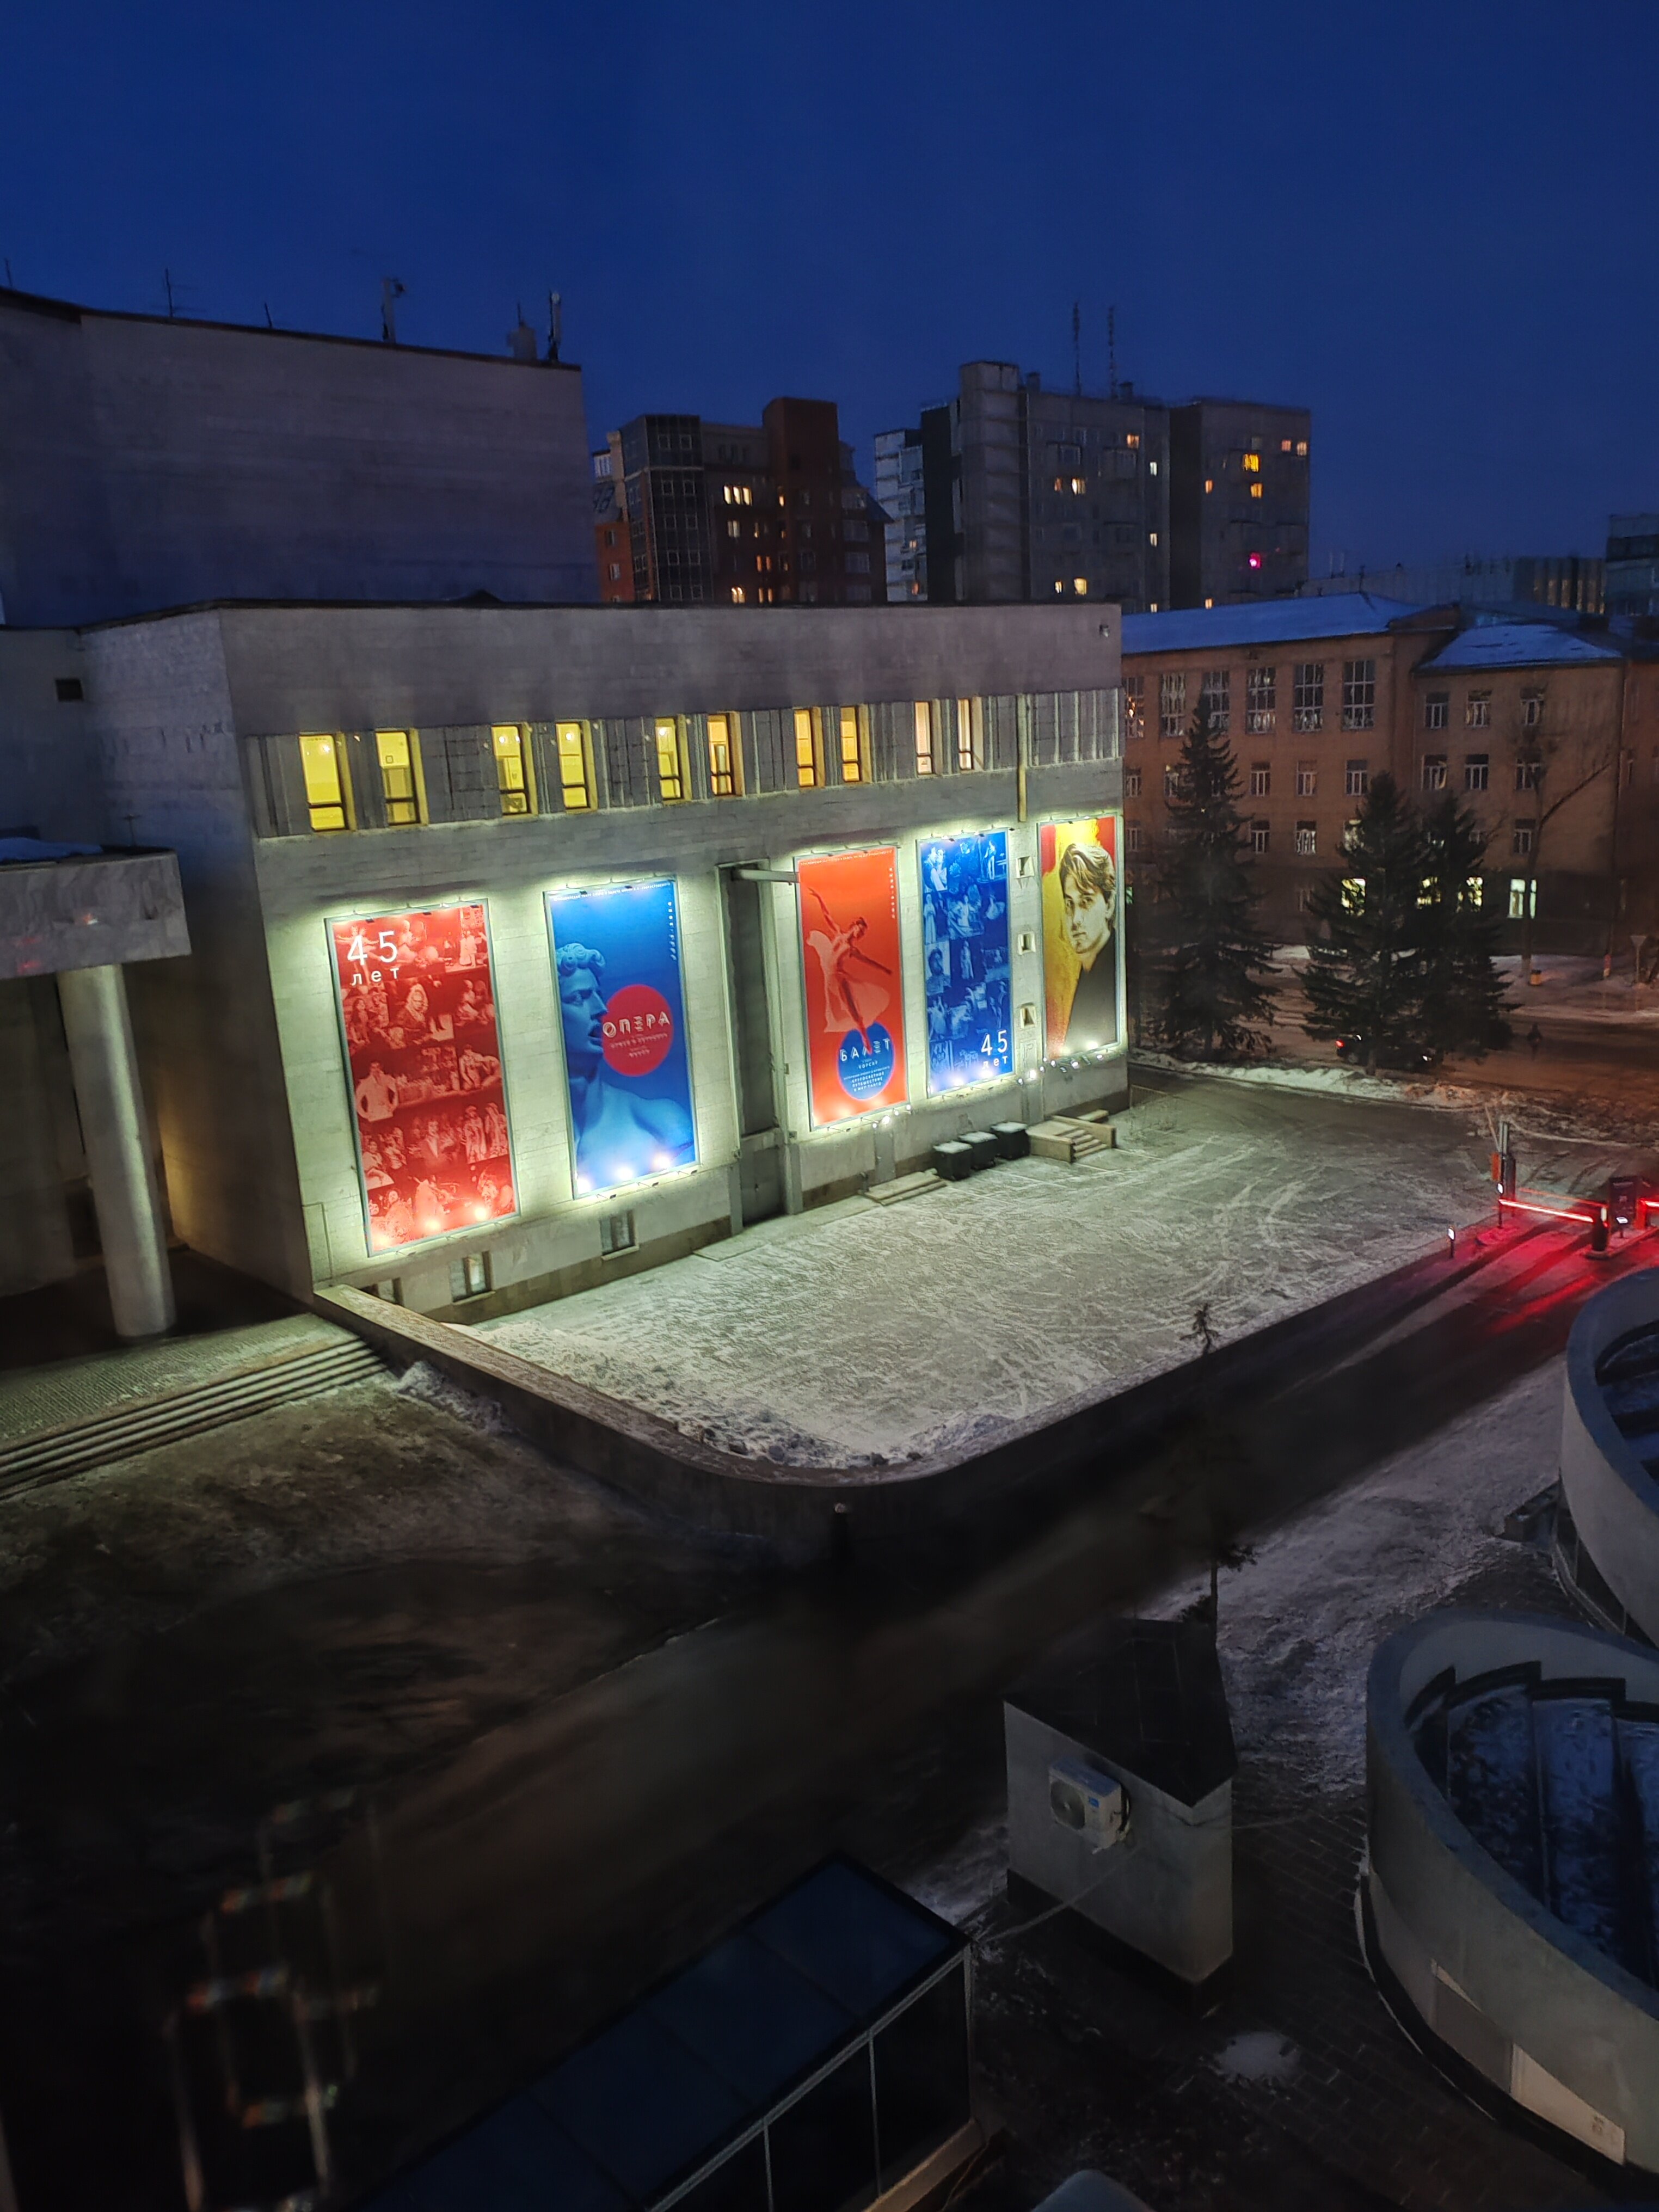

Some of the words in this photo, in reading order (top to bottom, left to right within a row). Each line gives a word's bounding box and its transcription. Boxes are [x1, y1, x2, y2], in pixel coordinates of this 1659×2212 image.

[347, 931, 397, 966] 45
[350, 967, 400, 986] лет
[603, 1011, 671, 1038] ОПЕРА
[981, 1030, 1007, 1056] 45
[982, 1055, 1008, 1070] лет
